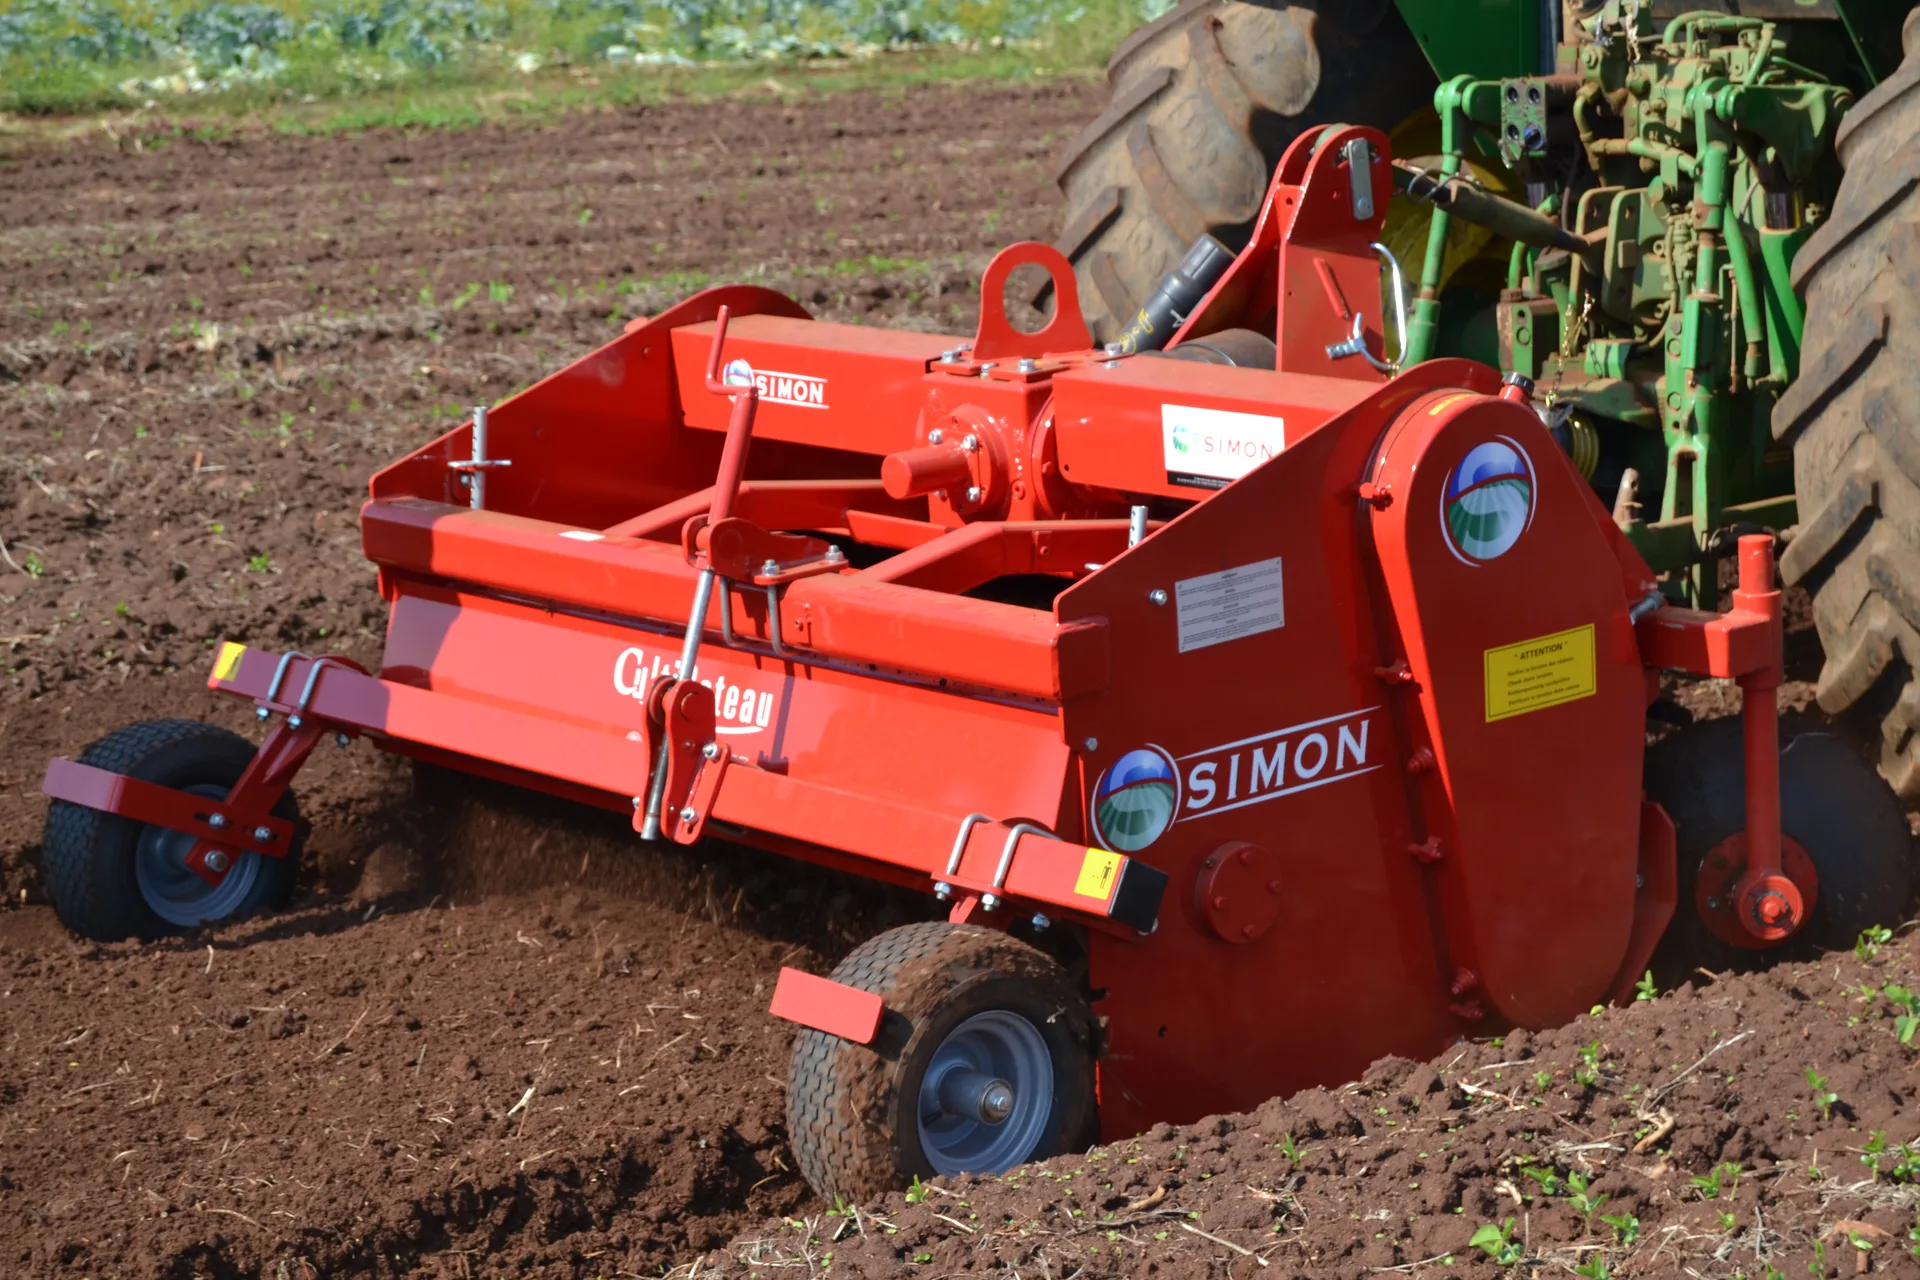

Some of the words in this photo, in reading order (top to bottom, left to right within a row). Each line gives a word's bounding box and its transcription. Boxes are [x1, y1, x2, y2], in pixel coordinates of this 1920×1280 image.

[755, 375, 824, 404] SIMON
[1204, 436, 1273, 459] SIMON
[1519, 643, 1563, 660] ATTENTION
[1186, 719, 1370, 809] SIMON
